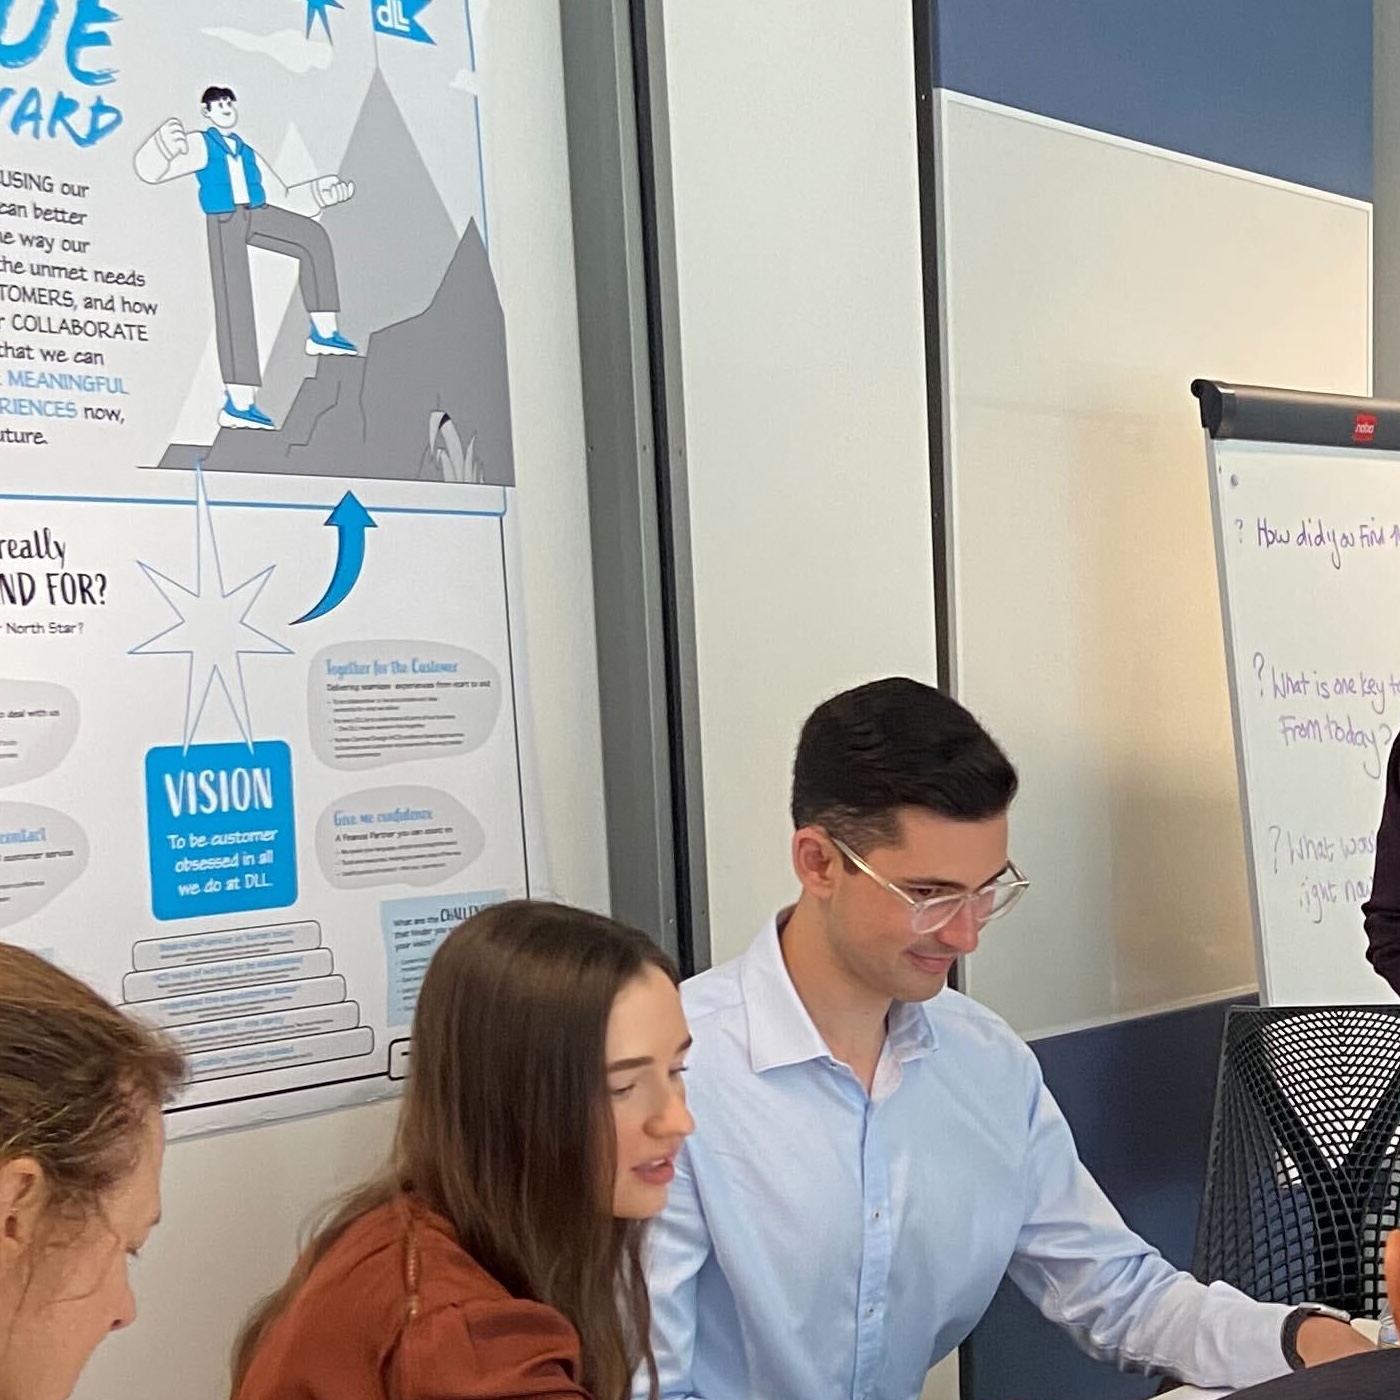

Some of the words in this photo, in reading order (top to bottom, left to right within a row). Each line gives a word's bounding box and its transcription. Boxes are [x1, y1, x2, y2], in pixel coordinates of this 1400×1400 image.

[61, 181, 90, 197] our
[32, 202, 88, 225] better
[20, 233, 55, 254] way
[61, 238, 90, 253] our
[30, 263, 88, 281] unmet
[94, 270, 146, 287] needs
[84, 295, 115, 311] and
[122, 296, 158, 315] how
[12, 313, 149, 341] COLLABORATE
[40, 348, 69, 363] we
[73, 352, 104, 365] can
[8, 369, 130, 395] MEANINGFUL
[84, 406, 125, 425] now,
[1257, 517, 1291, 549] How
[46, 572, 107, 605] FOR?
[6, 622, 46, 634] North
[48, 622, 84, 635] Star?
[373, 659, 388, 676] for
[391, 658, 407, 675] the
[1272, 666, 1311, 700] What
[1314, 670, 1331, 699] is
[1334, 678, 1357, 695] one
[1360, 669, 1386, 714] key
[1325, 713, 1393, 780] today?
[163, 767, 273, 818] VISION
[167, 834, 186, 850] To
[189, 832, 208, 848] be
[211, 829, 279, 846] customer
[175, 853, 240, 873] obsessed
[242, 851, 255, 867] in
[258, 850, 274, 865] all
[177, 883, 201, 897] we
[203, 877, 222, 894] do
[225, 876, 241, 891] at
